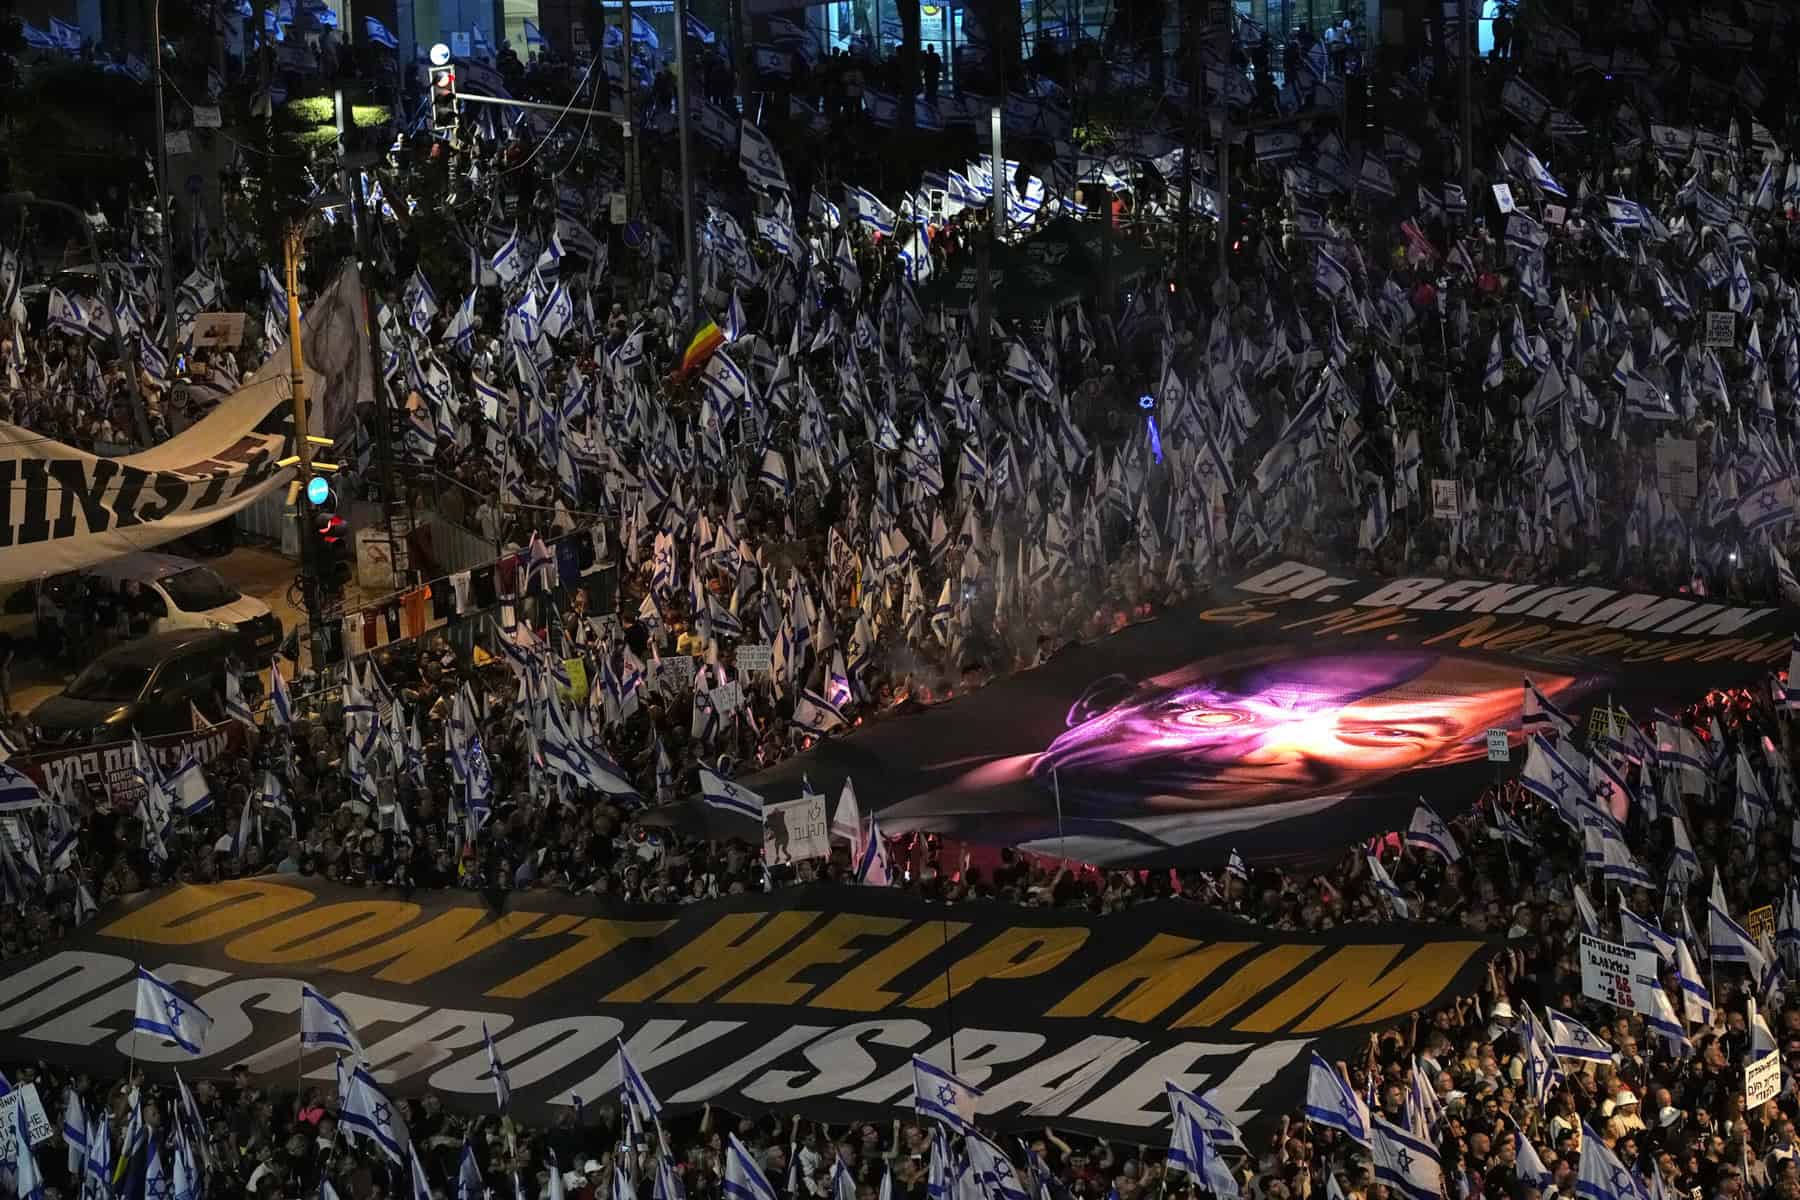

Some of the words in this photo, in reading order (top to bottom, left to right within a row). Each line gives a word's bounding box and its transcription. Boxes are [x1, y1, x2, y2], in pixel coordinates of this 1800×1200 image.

[1233, 561, 1359, 603] Dr.
[1353, 577, 1780, 636] BENJAMIN
[96, 879, 679, 999] DON'T
[599, 911, 1092, 1012] HELP
[1043, 933, 1487, 1033] HIM
[0, 951, 748, 1107] DESTROY
[664, 1019, 1321, 1127] ISRAEL
